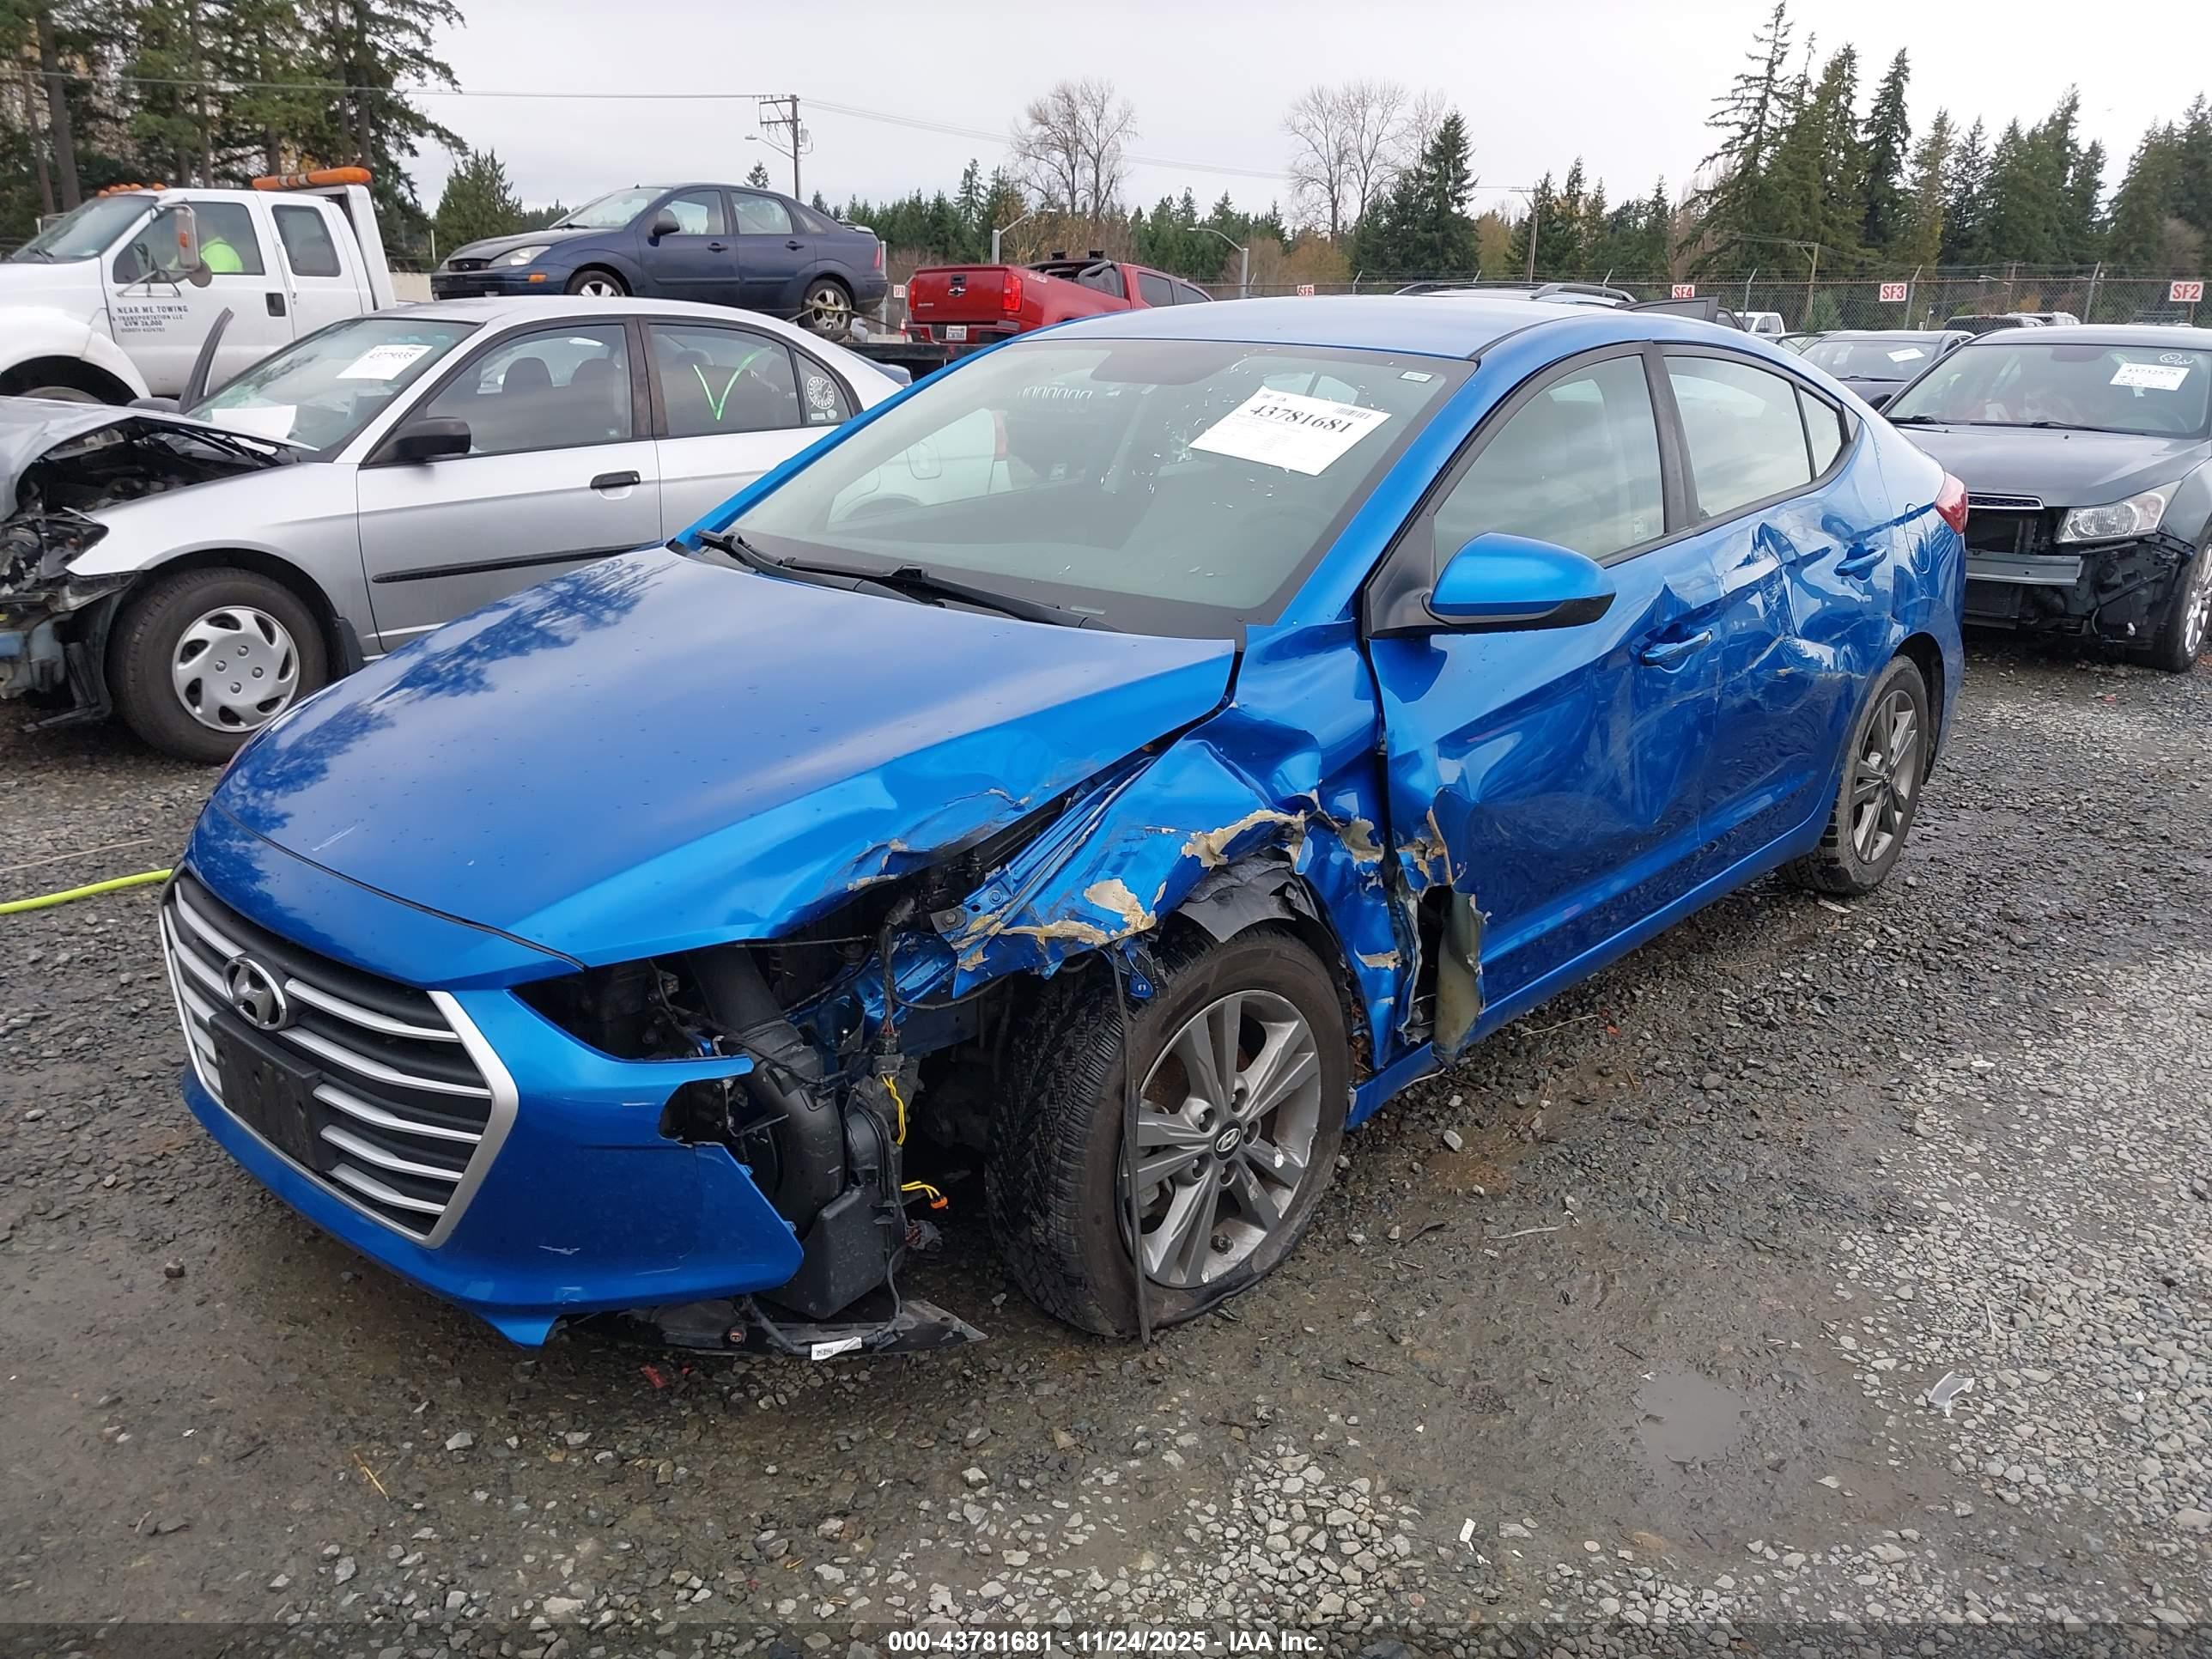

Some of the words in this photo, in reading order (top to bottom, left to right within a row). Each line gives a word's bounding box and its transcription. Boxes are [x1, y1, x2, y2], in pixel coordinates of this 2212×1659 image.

[1674, 286, 1692, 299] SF4
[1882, 285, 1905, 300] SF3
[2172, 284, 2200, 299] SF2
[1250, 404, 1354, 433] 43781681
